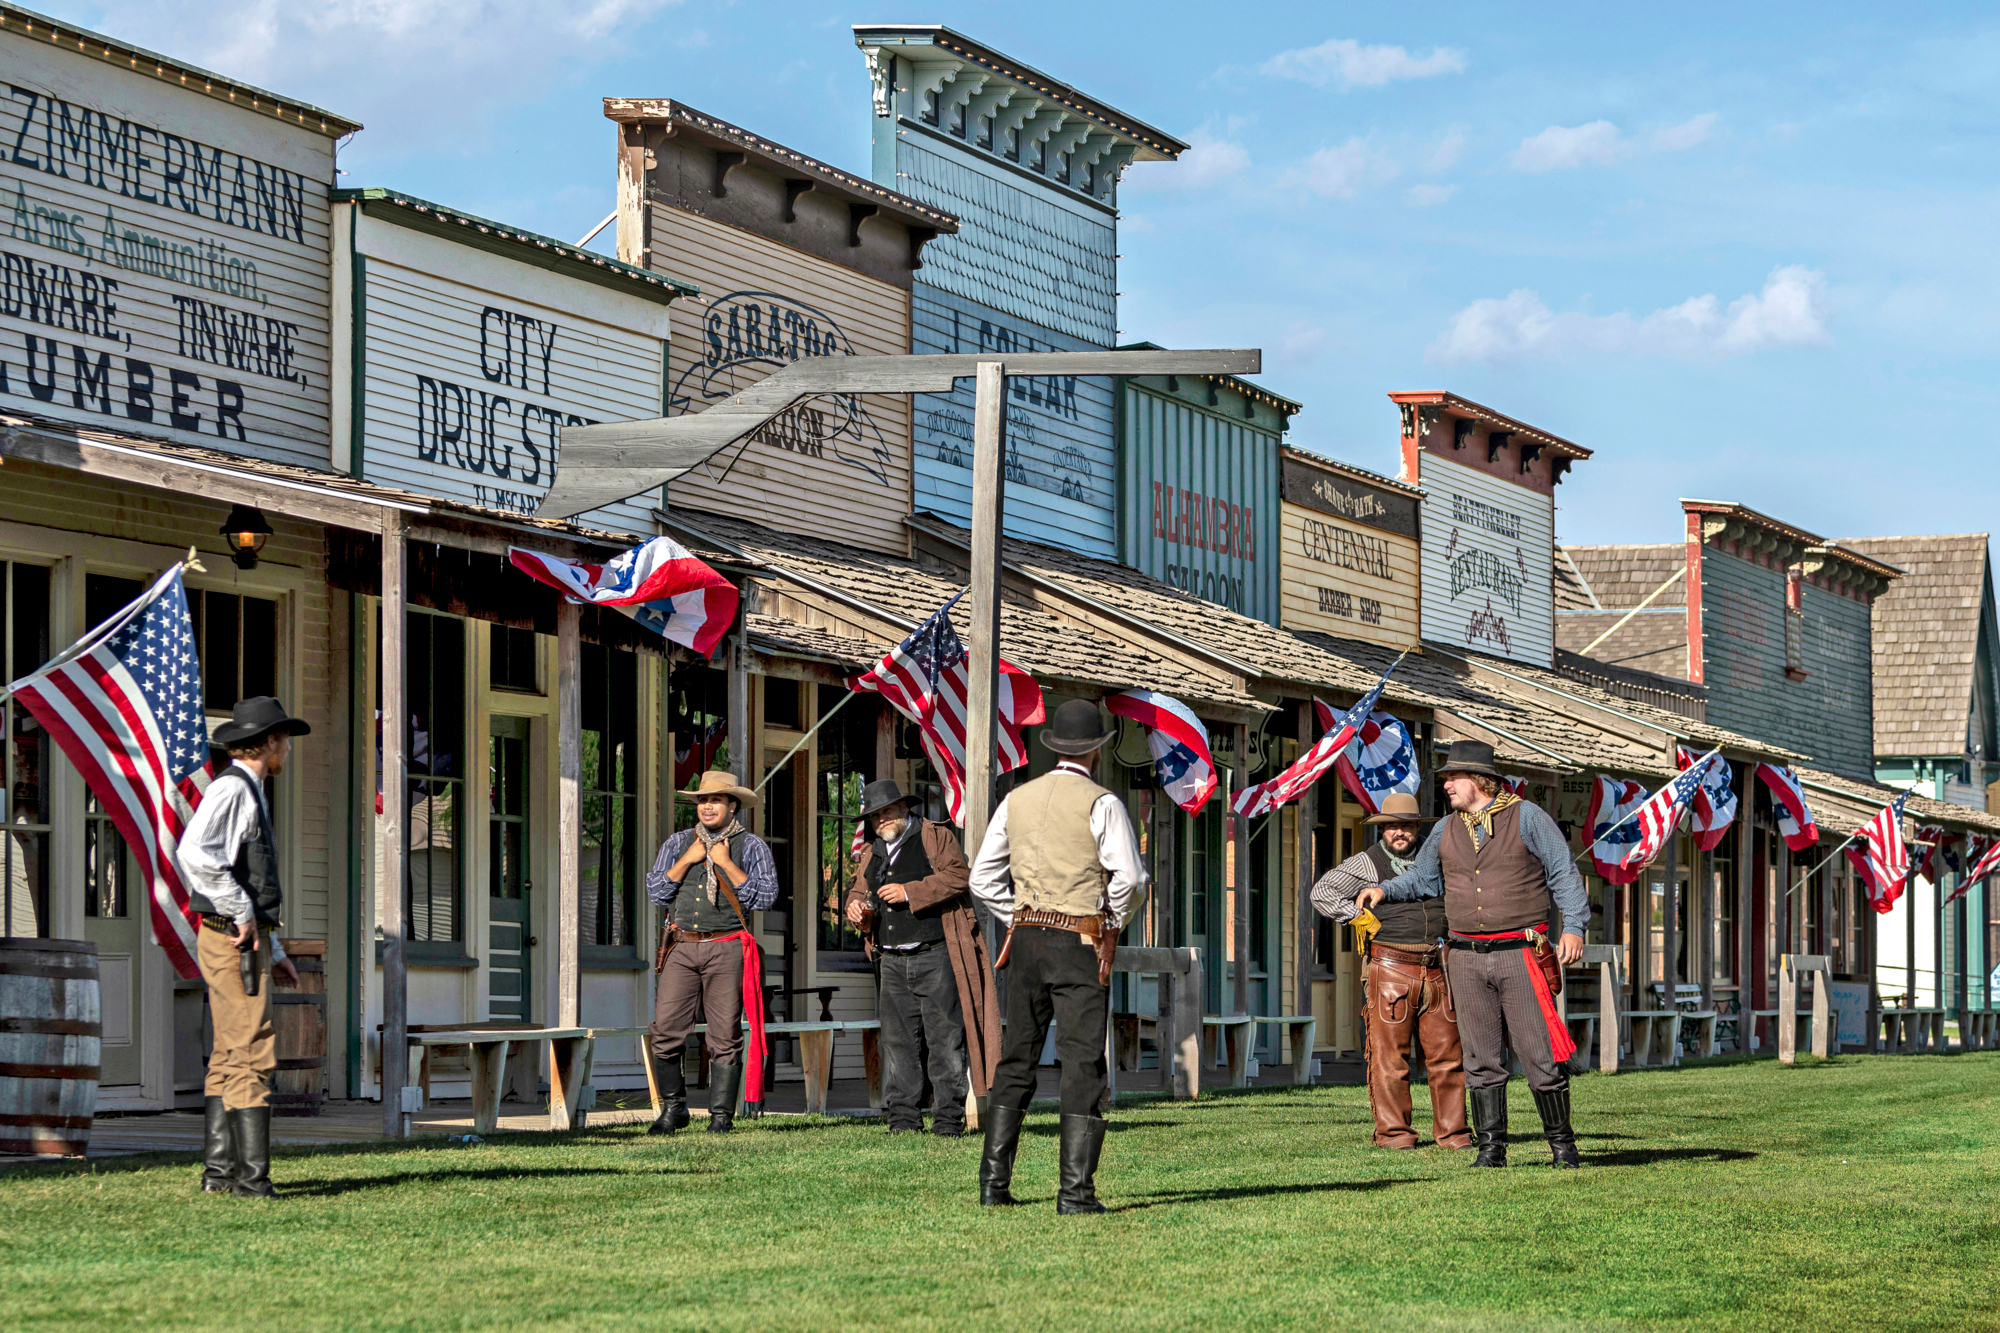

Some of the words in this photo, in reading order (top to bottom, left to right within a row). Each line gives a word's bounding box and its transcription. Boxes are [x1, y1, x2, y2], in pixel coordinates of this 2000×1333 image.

[10, 180, 93, 267] Arms,
[100, 204, 268, 309] Ammunition,
[0, 251, 132, 352] DWARE,
[172, 295, 308, 391] TINWARE,
[480, 306, 557, 396] CITY
[927, 409, 945, 439] DRY
[945, 409, 972, 449] GOODS
[1154, 481, 1254, 561] ALHAMBRA
[1324, 479, 1345, 514] SHAVE
[1354, 494, 1374, 518] BATH
[1303, 518, 1393, 581] CENTENNIAL
[1168, 564, 1242, 613] SALOON
[1318, 587, 1352, 618] BARBER
[1360, 598, 1381, 625] SHOP
[1450, 548, 1522, 620] RESTAURANT
